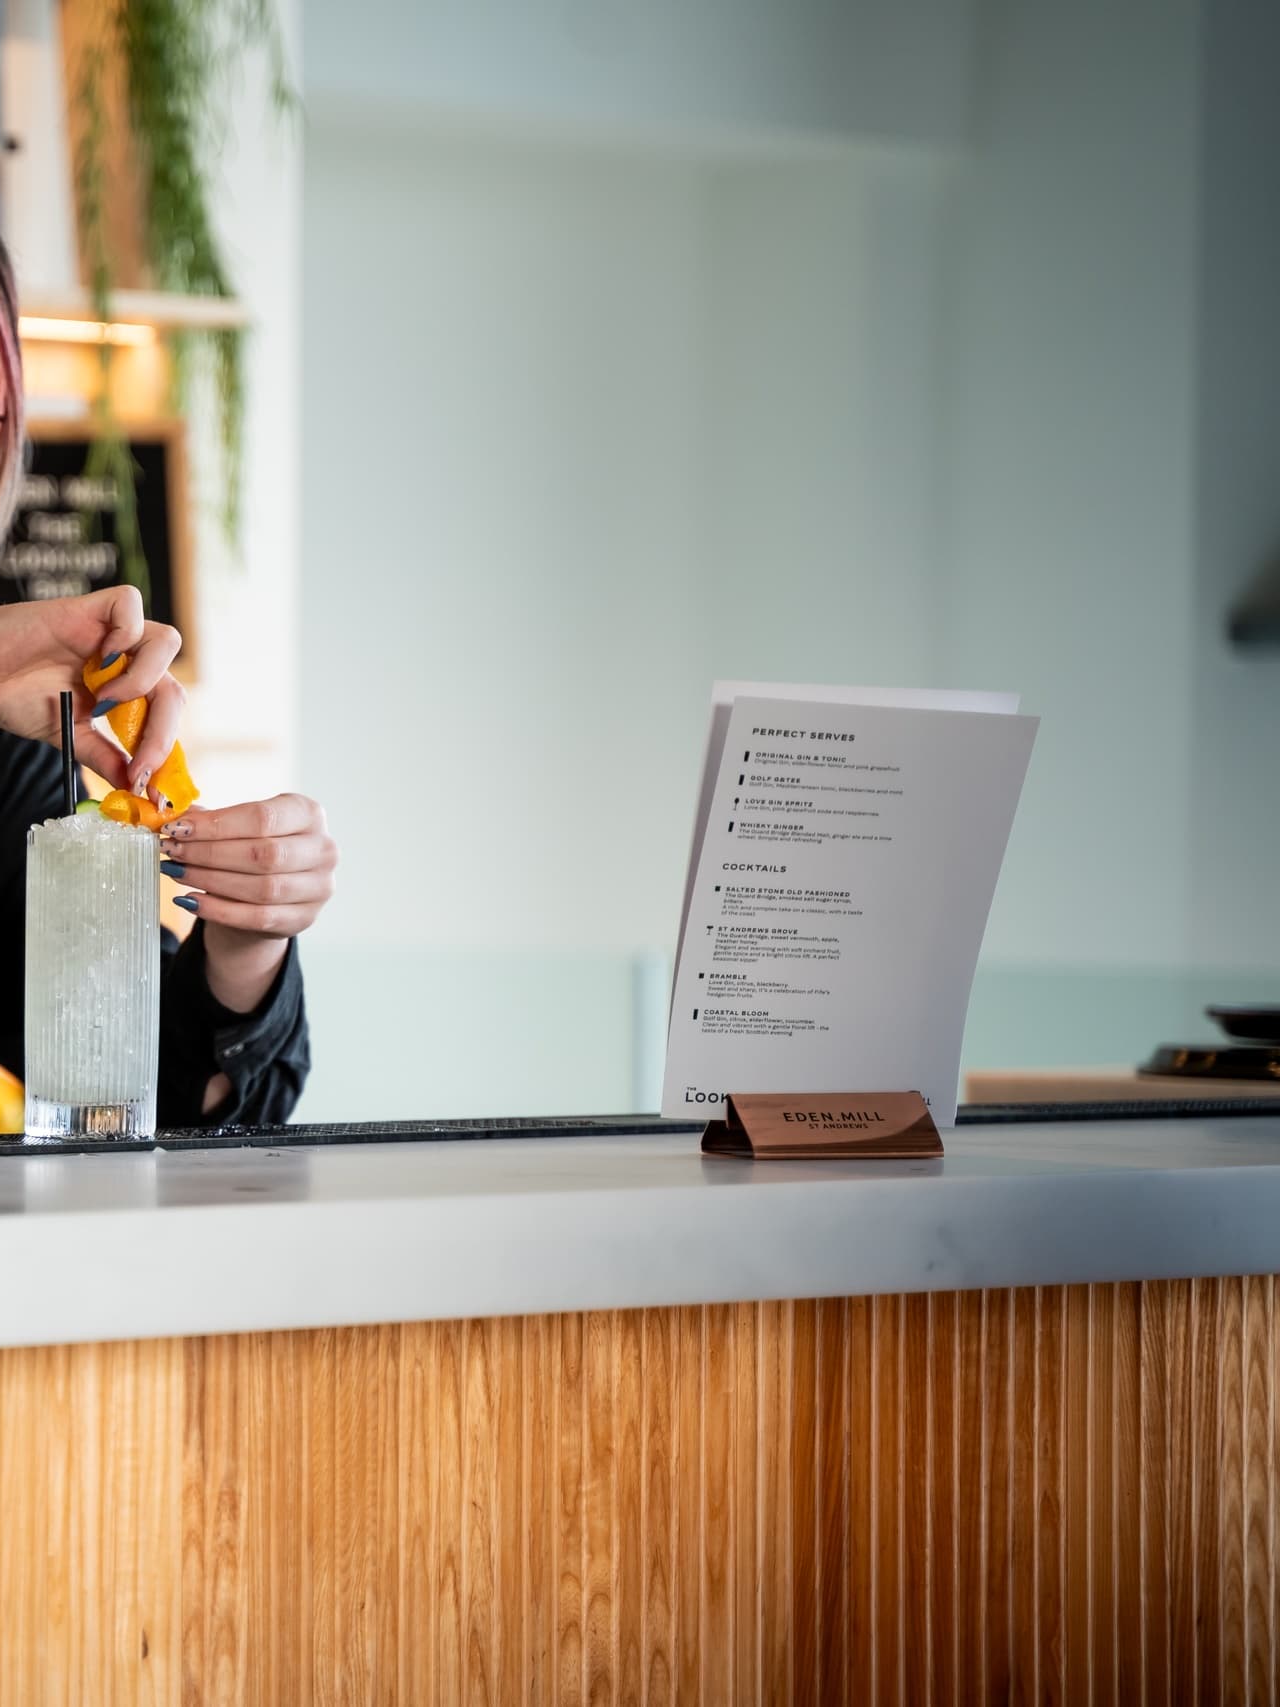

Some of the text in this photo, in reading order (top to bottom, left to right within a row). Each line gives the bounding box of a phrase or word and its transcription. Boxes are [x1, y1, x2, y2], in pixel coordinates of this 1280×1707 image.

[752, 728, 855, 741] PERFECT SERVES
[722, 863, 787, 872] COCKTAILS
[783, 1112, 885, 1122] EDEN.MILL
